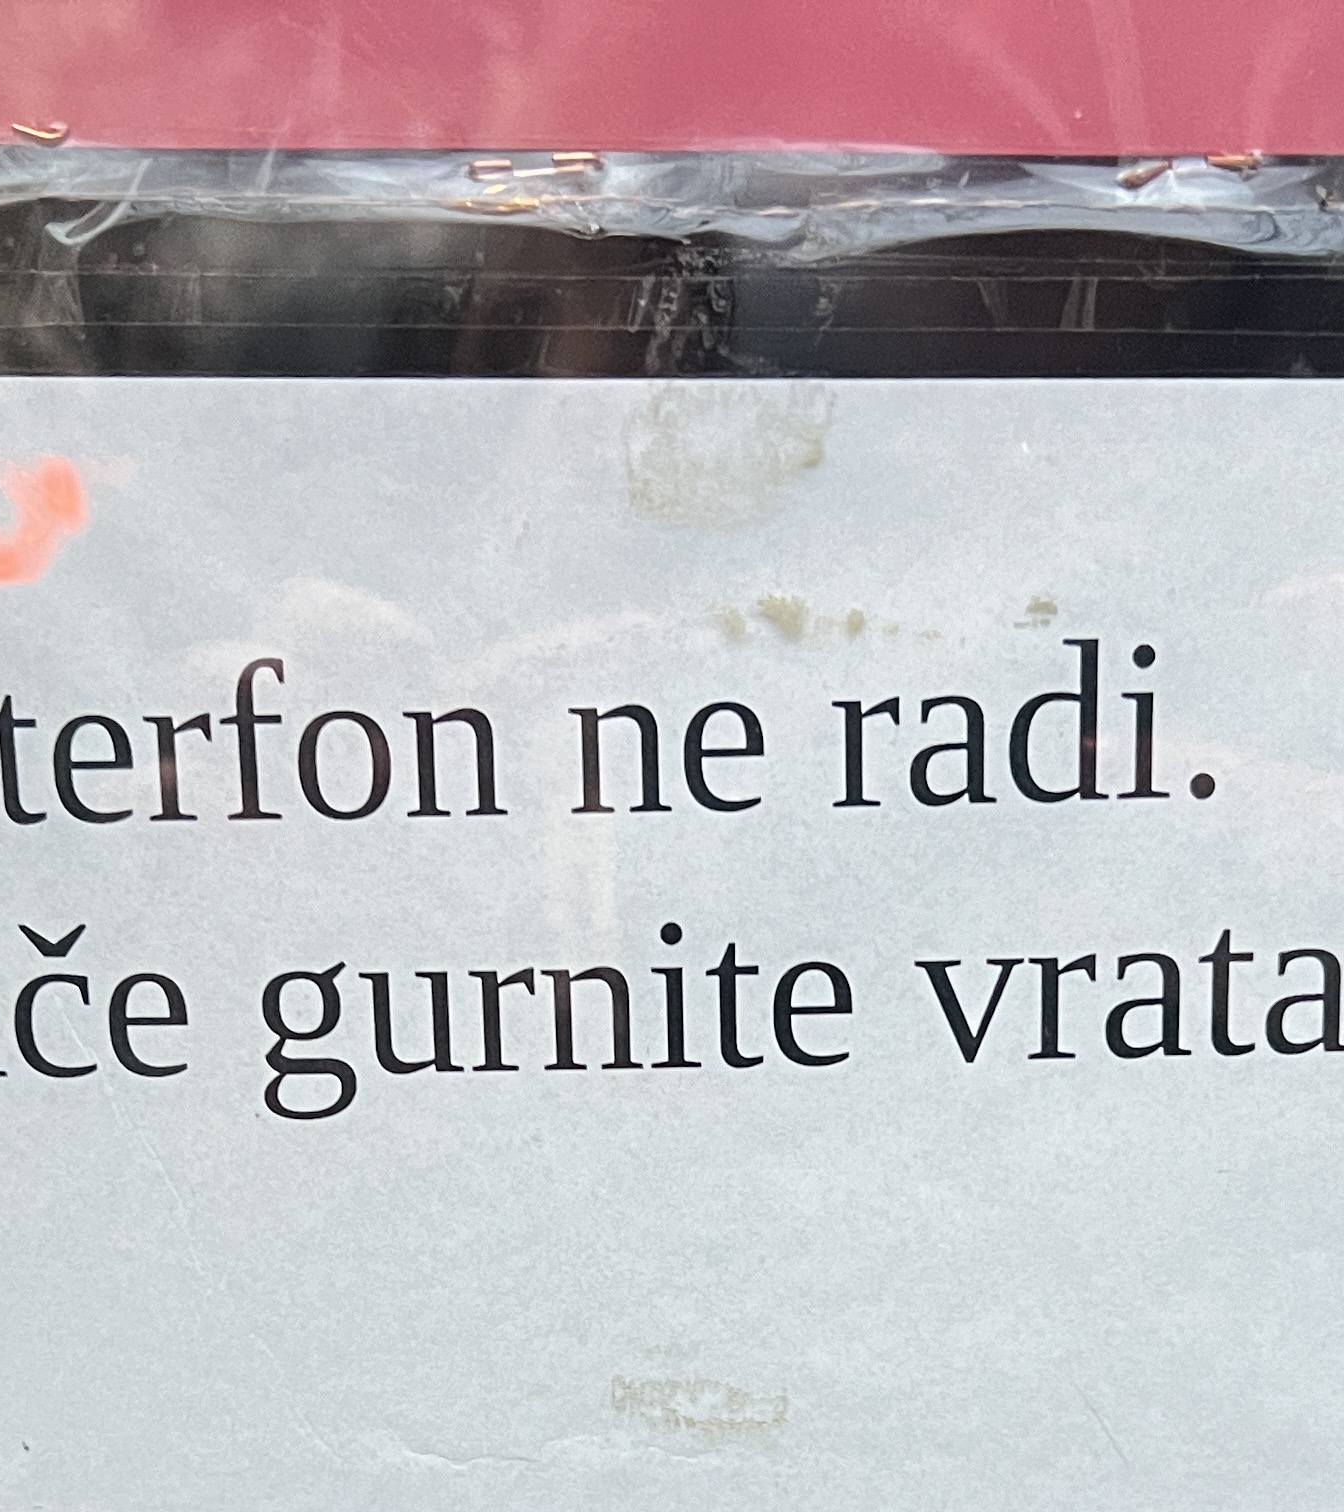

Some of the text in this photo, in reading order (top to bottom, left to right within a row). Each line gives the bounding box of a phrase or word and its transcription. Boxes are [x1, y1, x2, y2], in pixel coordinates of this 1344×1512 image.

[567, 700, 766, 814] ne
[830, 637, 1217, 809] radi.
[260, 921, 854, 1121] gurnite
